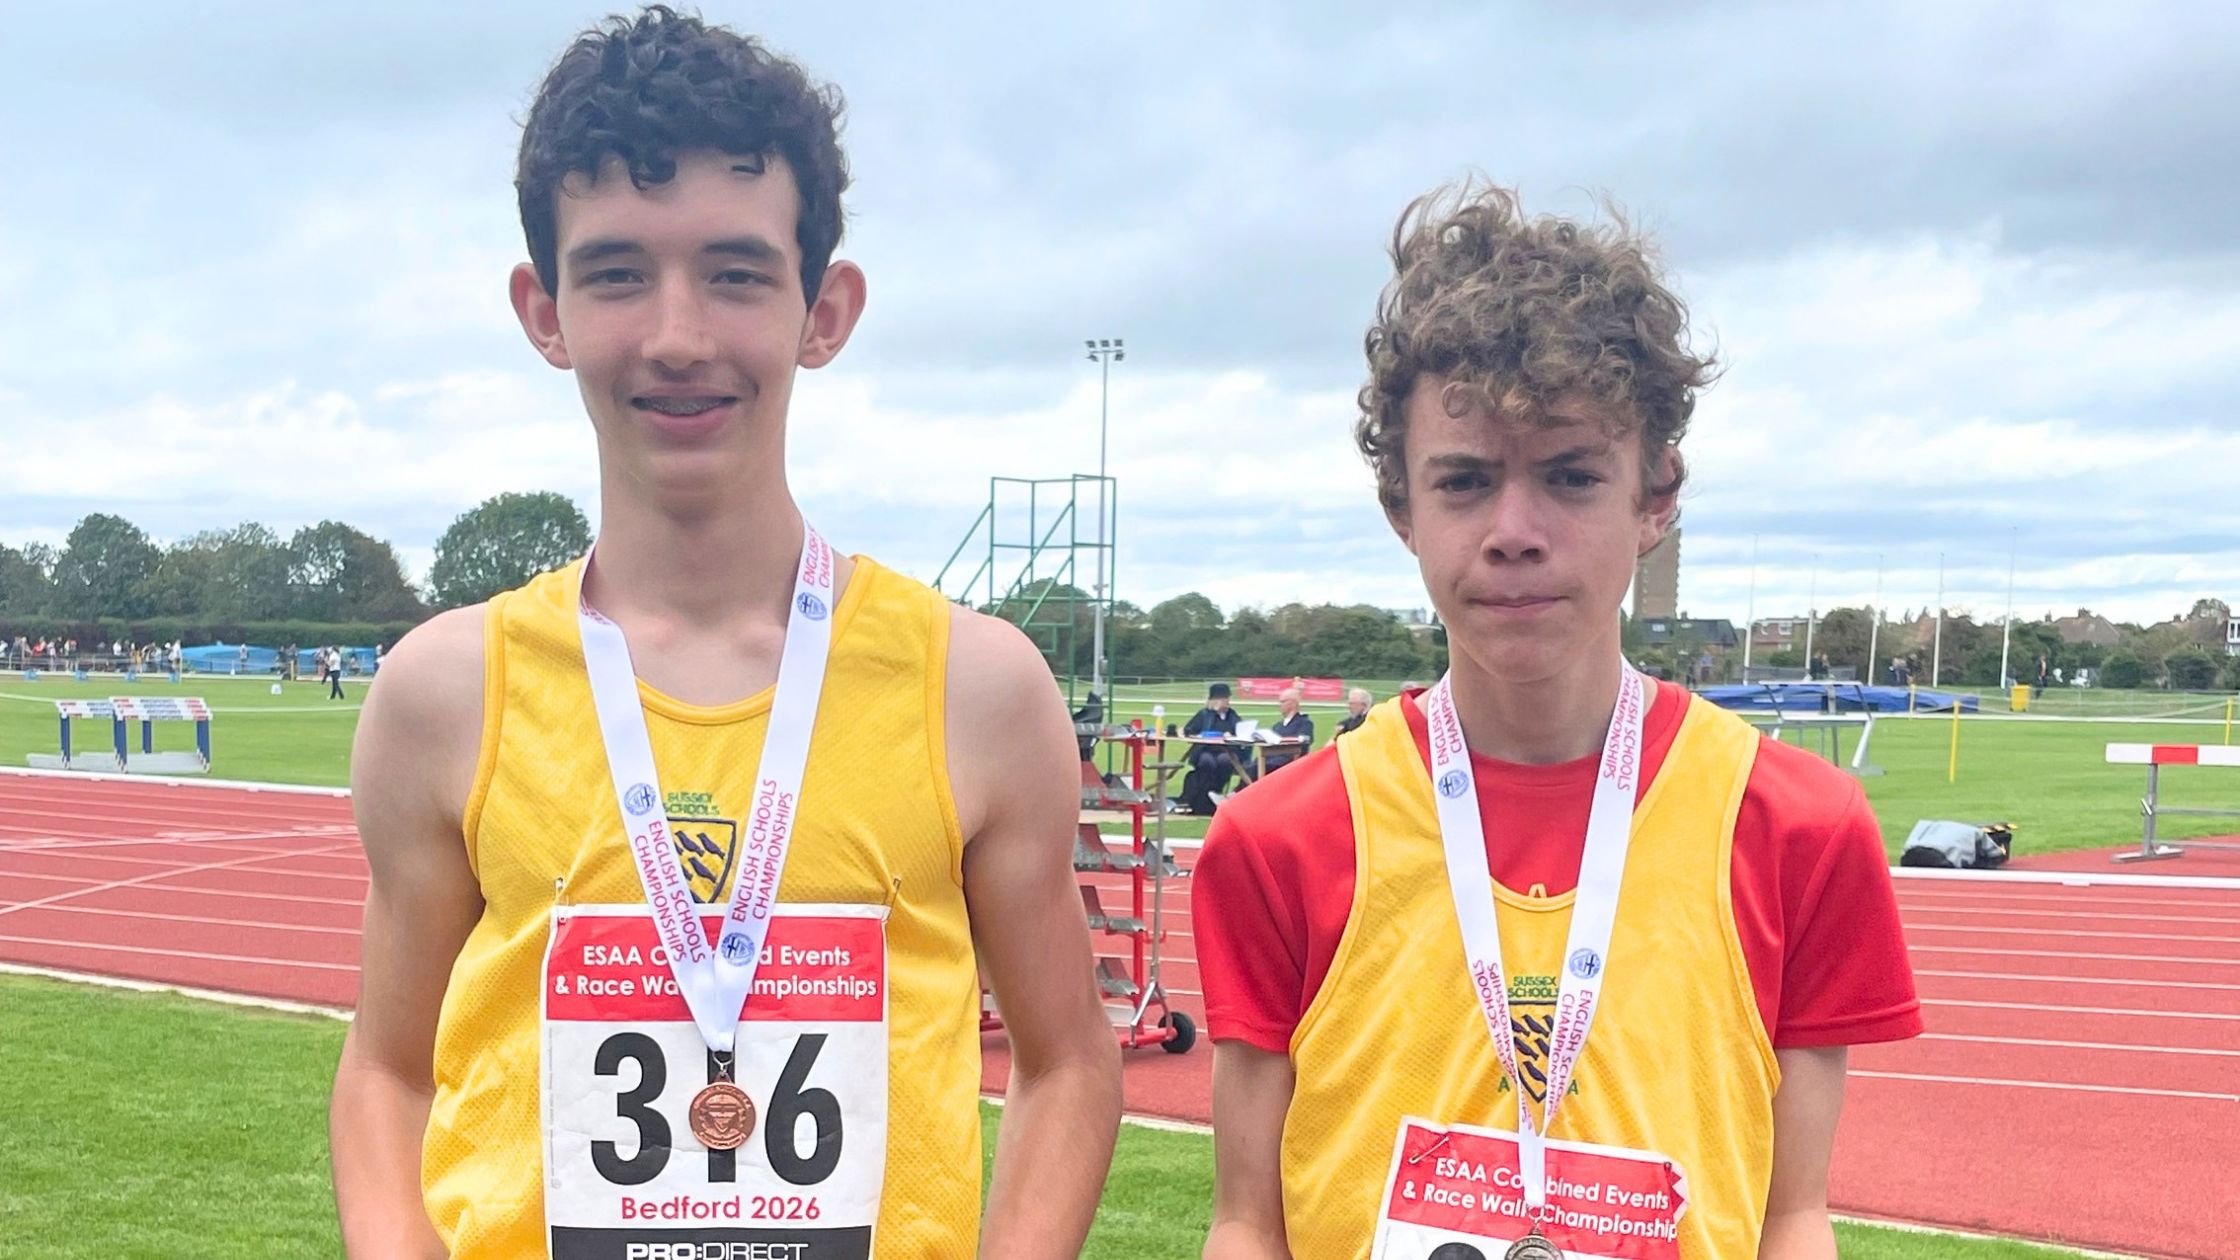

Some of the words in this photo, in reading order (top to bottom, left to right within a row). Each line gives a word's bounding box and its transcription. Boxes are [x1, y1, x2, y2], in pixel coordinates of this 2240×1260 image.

[1432, 709, 1449, 766] ENGLISH
[1617, 727, 1636, 791] SCHOOLS
[732, 856, 760, 923] ENGLISH
[750, 779, 777, 852] SCHOOLS
[752, 792, 793, 920] CHAMPIONSHIPS
[635, 835, 687, 962] CHAMPIONSHIPS
[649, 820, 678, 886] ENGLISH
[671, 890, 705, 963] SCHOOLS
[583, 946, 643, 966] ESAA
[781, 945, 850, 966] Events
[1513, 976, 1557, 986] SUSSEX
[555, 976, 569, 994] &
[577, 976, 634, 996] Race
[751, 975, 877, 1000] mpionships
[1472, 959, 1500, 1029] SCHOOLS
[1566, 989, 1593, 1052] ENGLISH
[622, 1196, 740, 1220] Bedford
[752, 1196, 821, 1220] 2026
[1402, 1181, 1416, 1199] &
[1424, 1183, 1476, 1209] Race
[1543, 1204, 1677, 1242] Championship
[1435, 1157, 1487, 1183] ESAA
[1493, 1167, 1600, 1202] Cobined
[1605, 1184, 1669, 1210] Events
